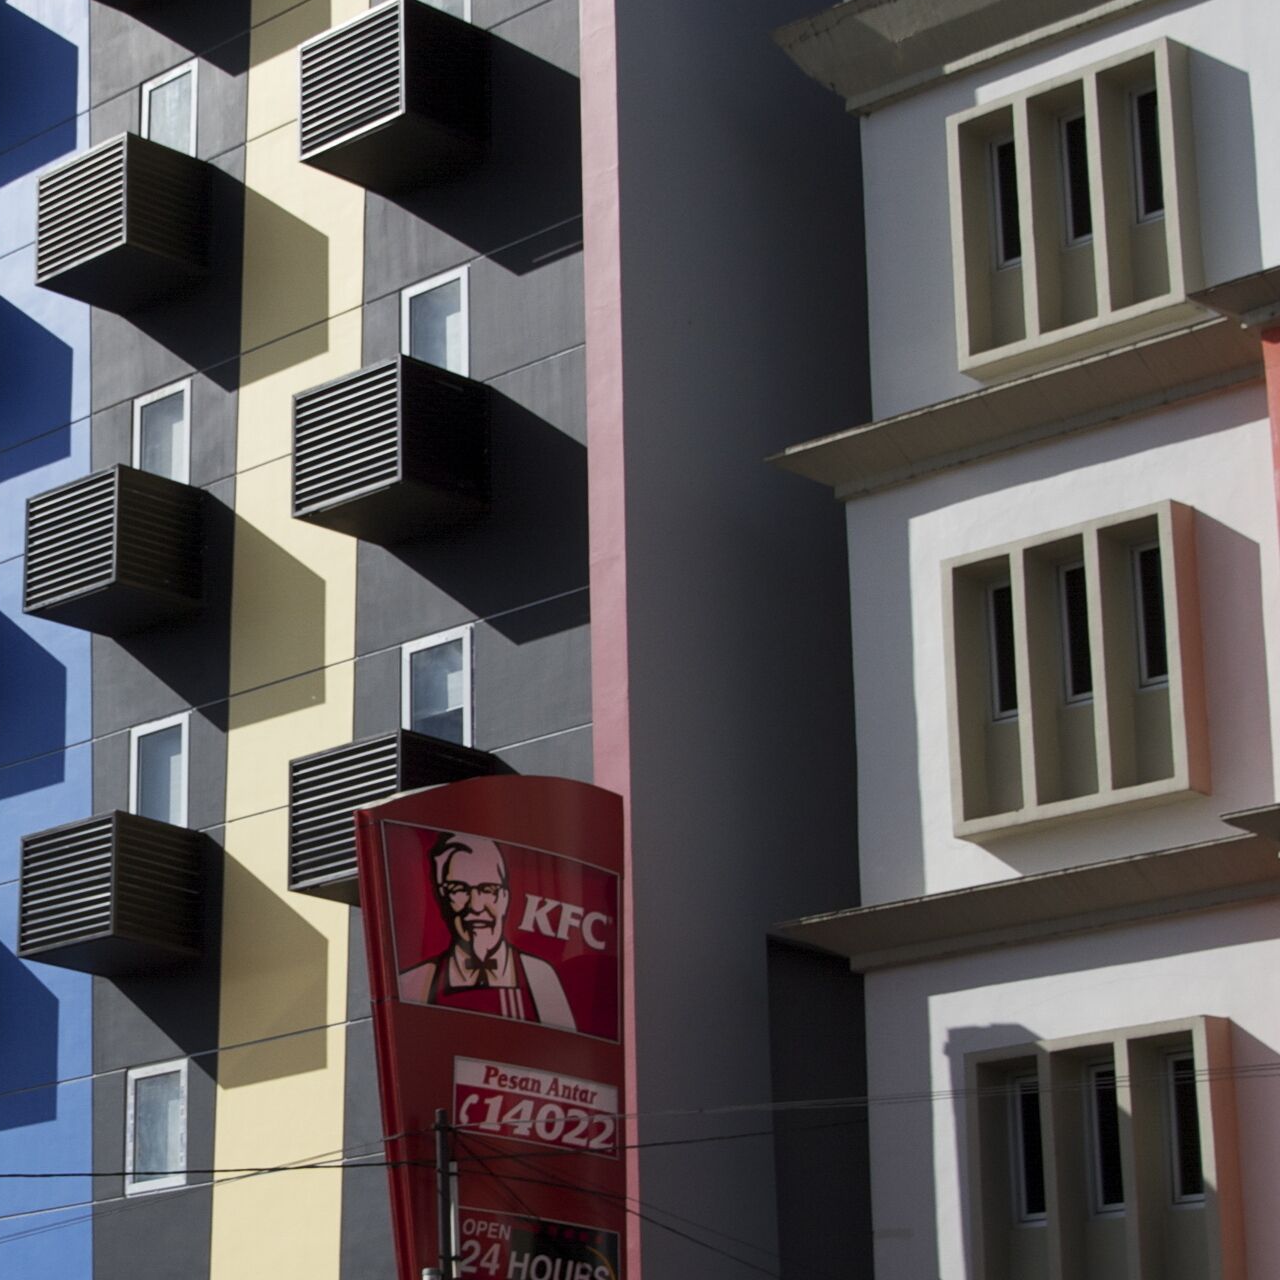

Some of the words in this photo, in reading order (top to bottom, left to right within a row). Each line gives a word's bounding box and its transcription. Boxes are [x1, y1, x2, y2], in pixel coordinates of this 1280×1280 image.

[518, 893, 609, 951] KFC
[483, 1065, 542, 1095] Pesan
[546, 1076, 598, 1105] Antar
[479, 1094, 615, 1154] 14022
[462, 1218, 512, 1241] OPEN
[460, 1239, 501, 1276] 24
